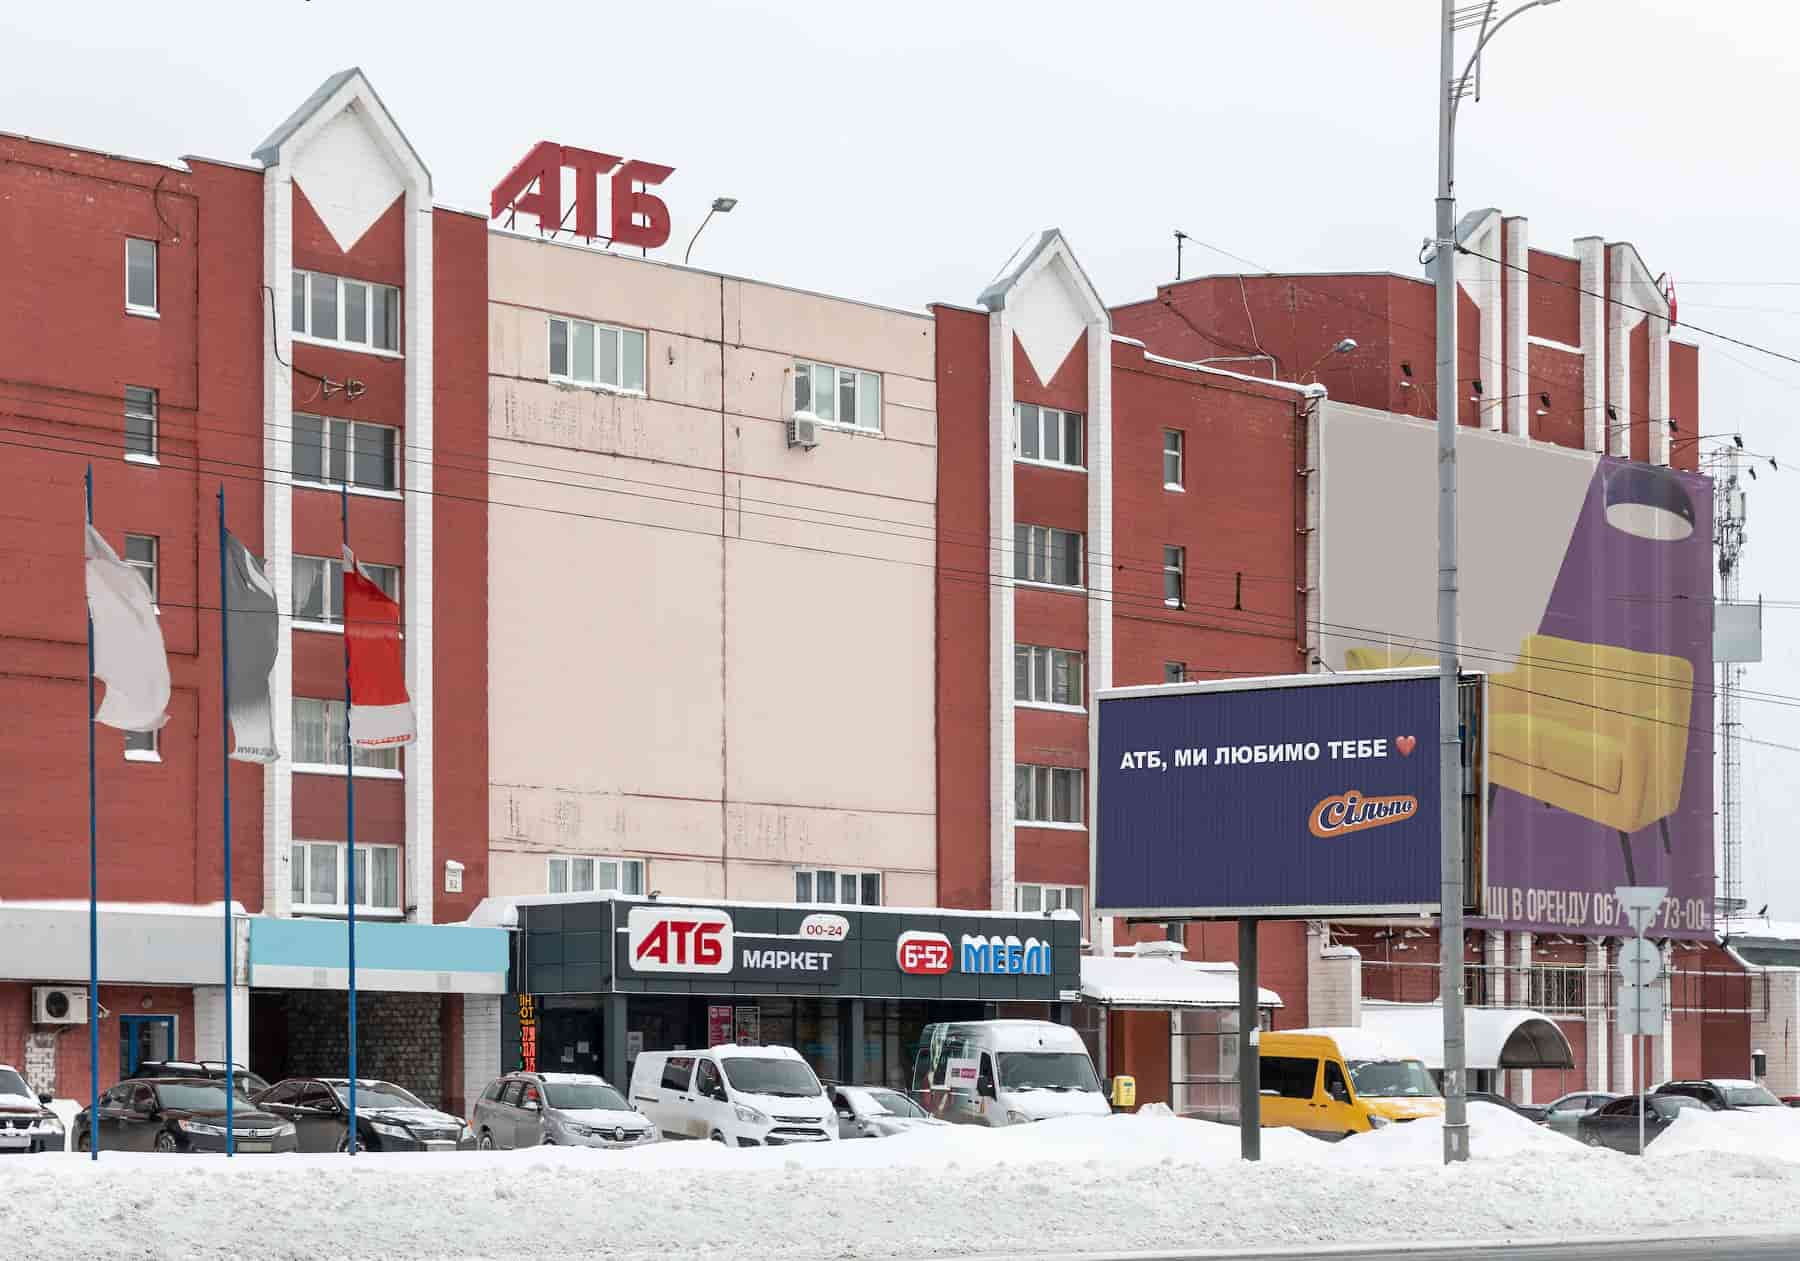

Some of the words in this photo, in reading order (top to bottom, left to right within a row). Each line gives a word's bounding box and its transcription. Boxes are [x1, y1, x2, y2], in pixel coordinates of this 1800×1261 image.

[490, 140, 676, 249] АТБ
[1120, 750, 1168, 772] АТБ,
[1174, 748, 1208, 768] МИ
[1214, 743, 1320, 766] ЛЮБИМО
[1327, 738, 1388, 760] ТЕБЕ
[1318, 796, 1413, 831] Сільпо
[1511, 887, 1523, 921] В
[1527, 888, 1590, 928] ОРЕНДУ
[636, 920, 727, 966] АТБ
[806, 924, 843, 937] 00-24
[742, 949, 833, 971] МАРКЕТ
[960, 938, 1051, 976] МЕБЛІ
